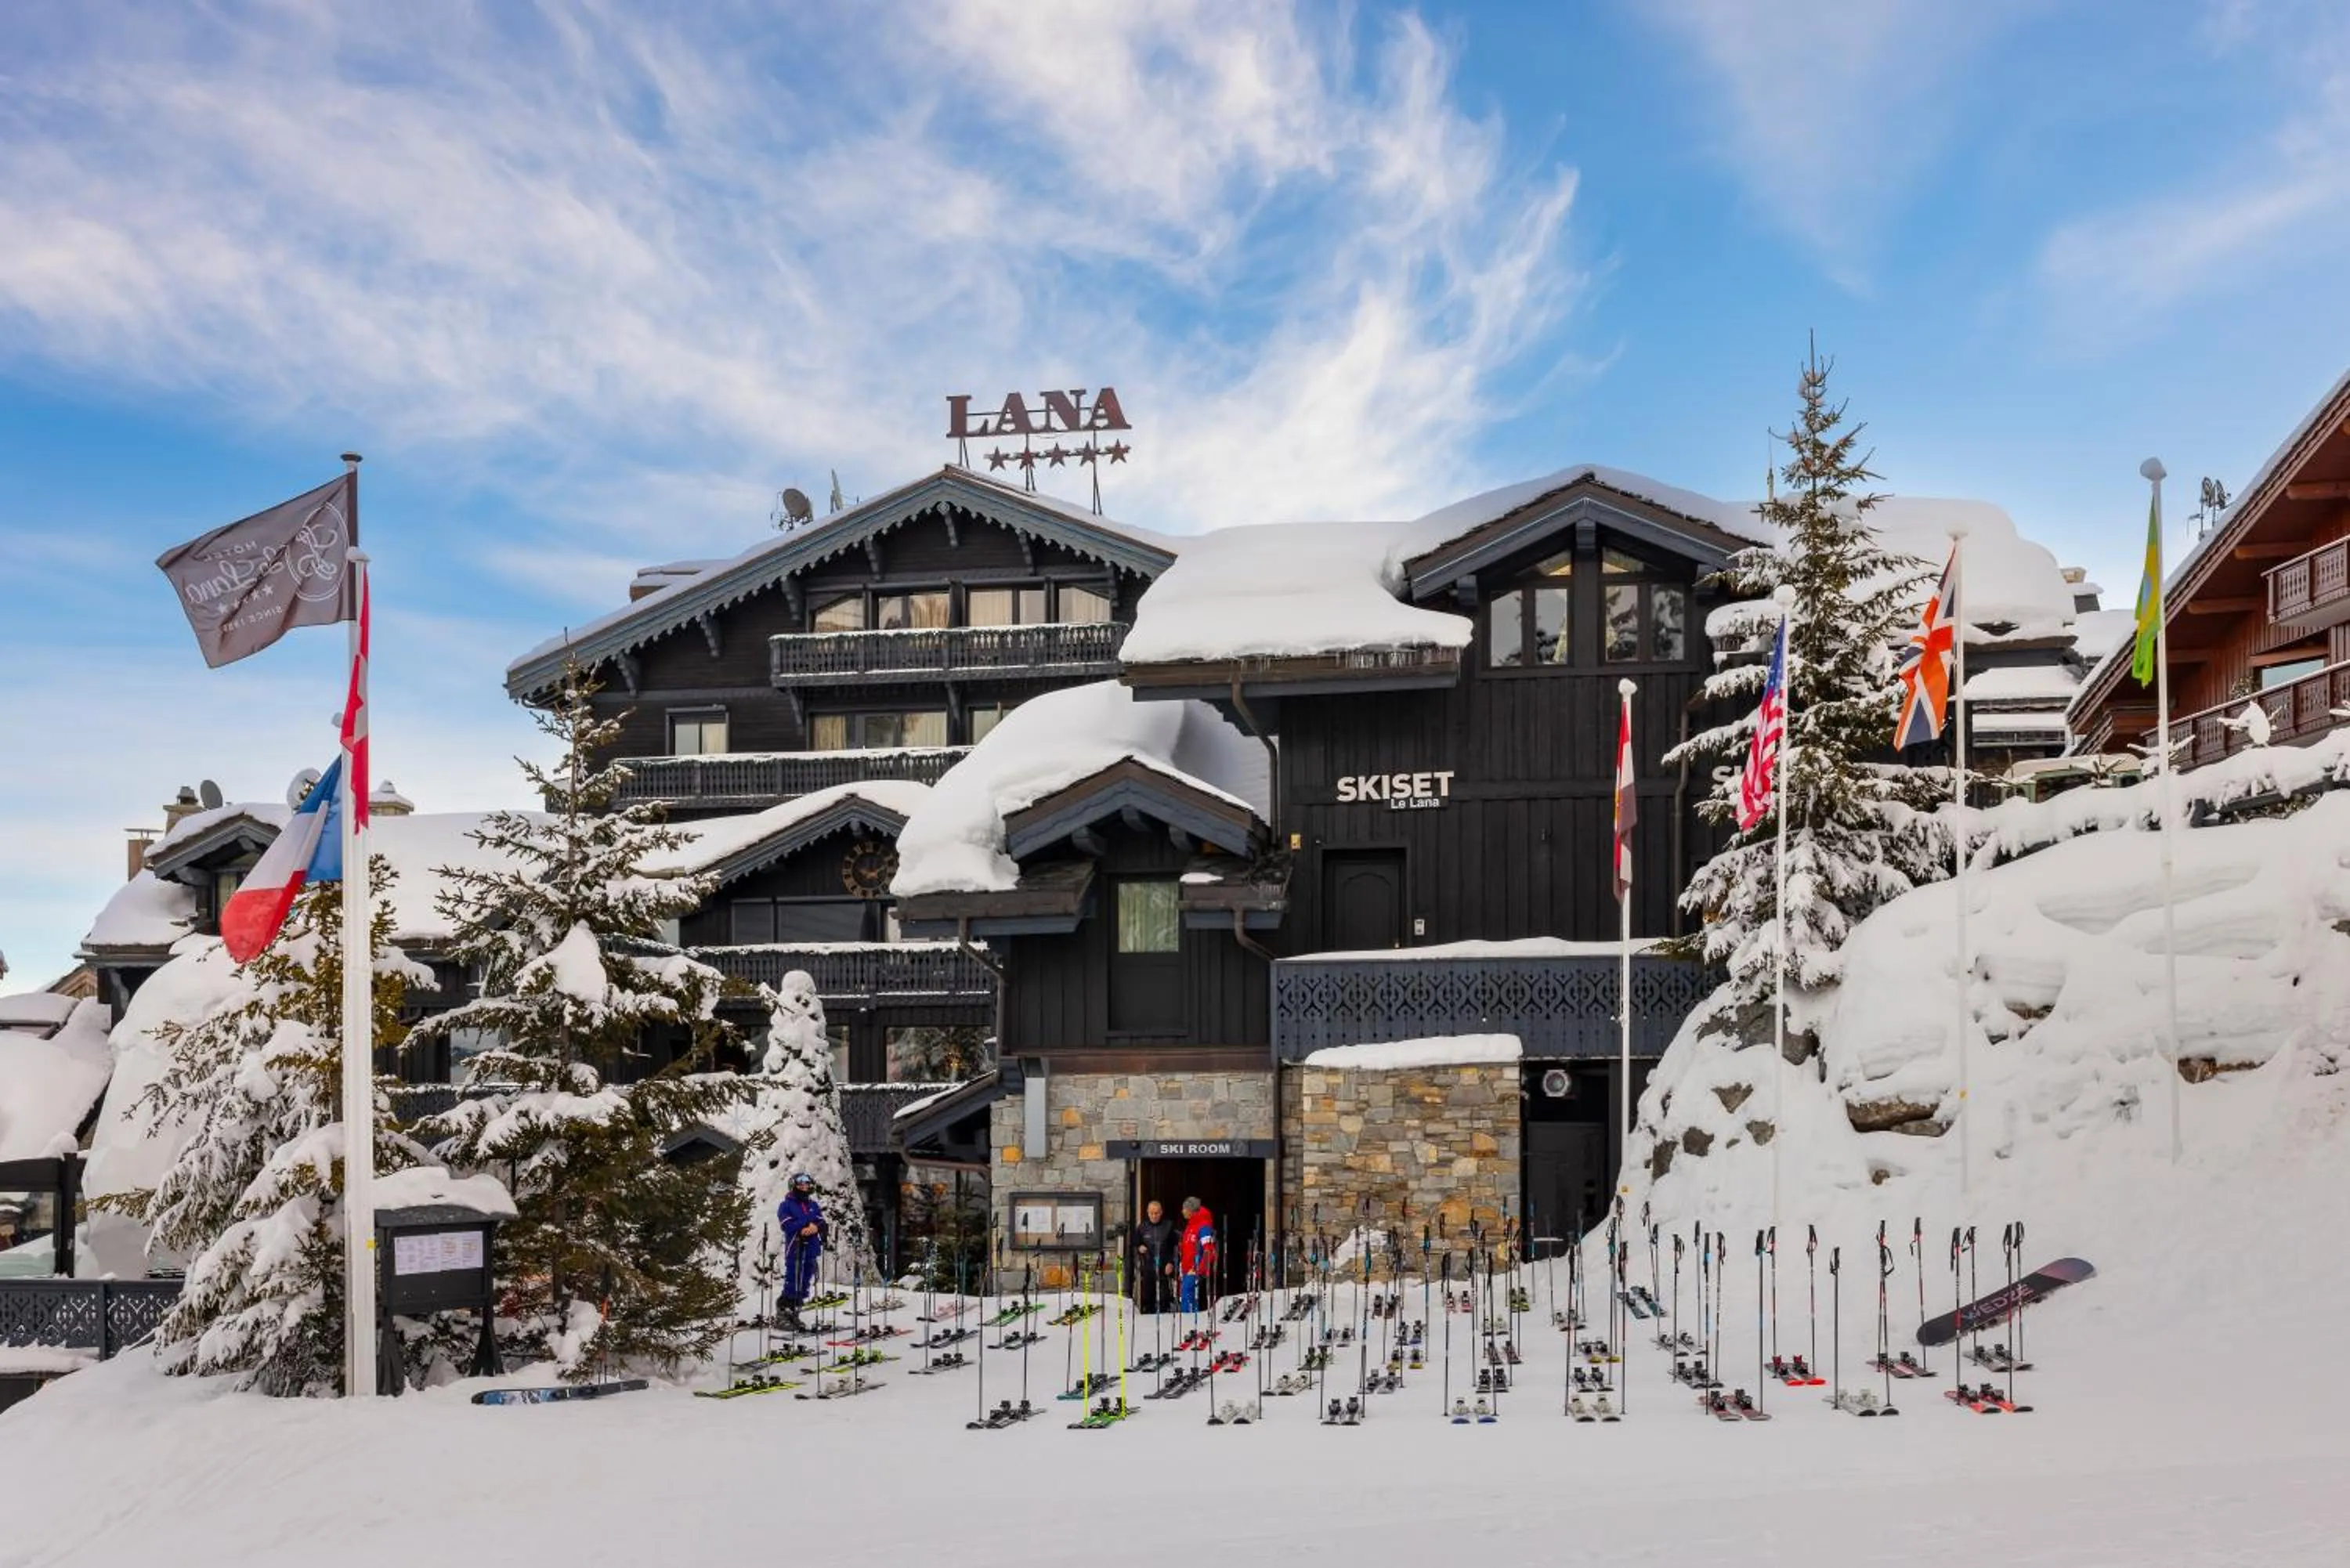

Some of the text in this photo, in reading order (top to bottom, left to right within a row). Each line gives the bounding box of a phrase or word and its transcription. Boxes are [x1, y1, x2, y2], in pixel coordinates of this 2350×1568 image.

[946, 387, 1132, 438] LANA
[1336, 771, 1455, 802] SKISET
[1390, 797, 1440, 809] Le Lana
[1160, 1143, 1230, 1154] SKI ROOM
